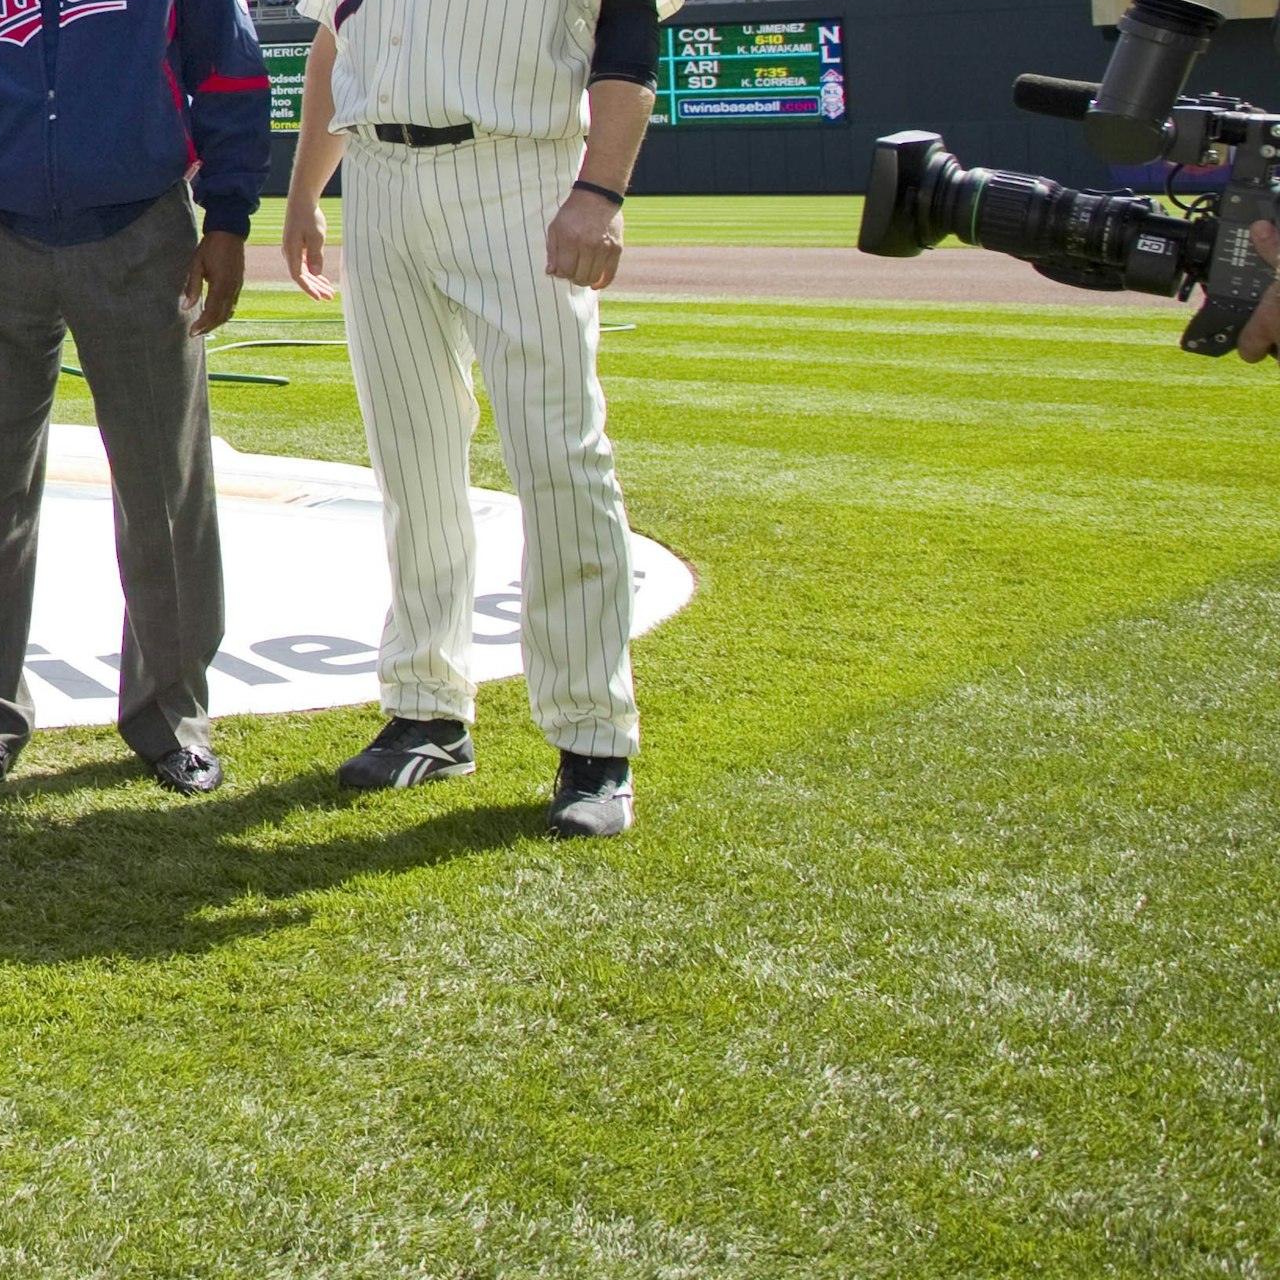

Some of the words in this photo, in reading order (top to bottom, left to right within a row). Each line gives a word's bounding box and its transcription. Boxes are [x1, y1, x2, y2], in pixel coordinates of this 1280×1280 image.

[743, 25, 754, 35] U.
[756, 23, 805, 34] JIMENEZ
[678, 28, 722, 42] COL
[755, 34, 783, 45] 6:10
[681, 43, 721, 56] ATL
[737, 45, 749, 54] K.
[751, 43, 813, 54] KAWAKAMI
[683, 61, 719, 74] ARI
[753, 67, 788, 77] 7:35
[688, 76, 717, 89] SD
[741, 78, 753, 87] K.
[754, 77, 807, 87] CORREIA
[271, 85, 304, 95] abrera
[271, 97, 292, 107] hoo
[683, 101, 817, 114] twinsbaseball.com
[1142, 241, 1161, 251] HD
